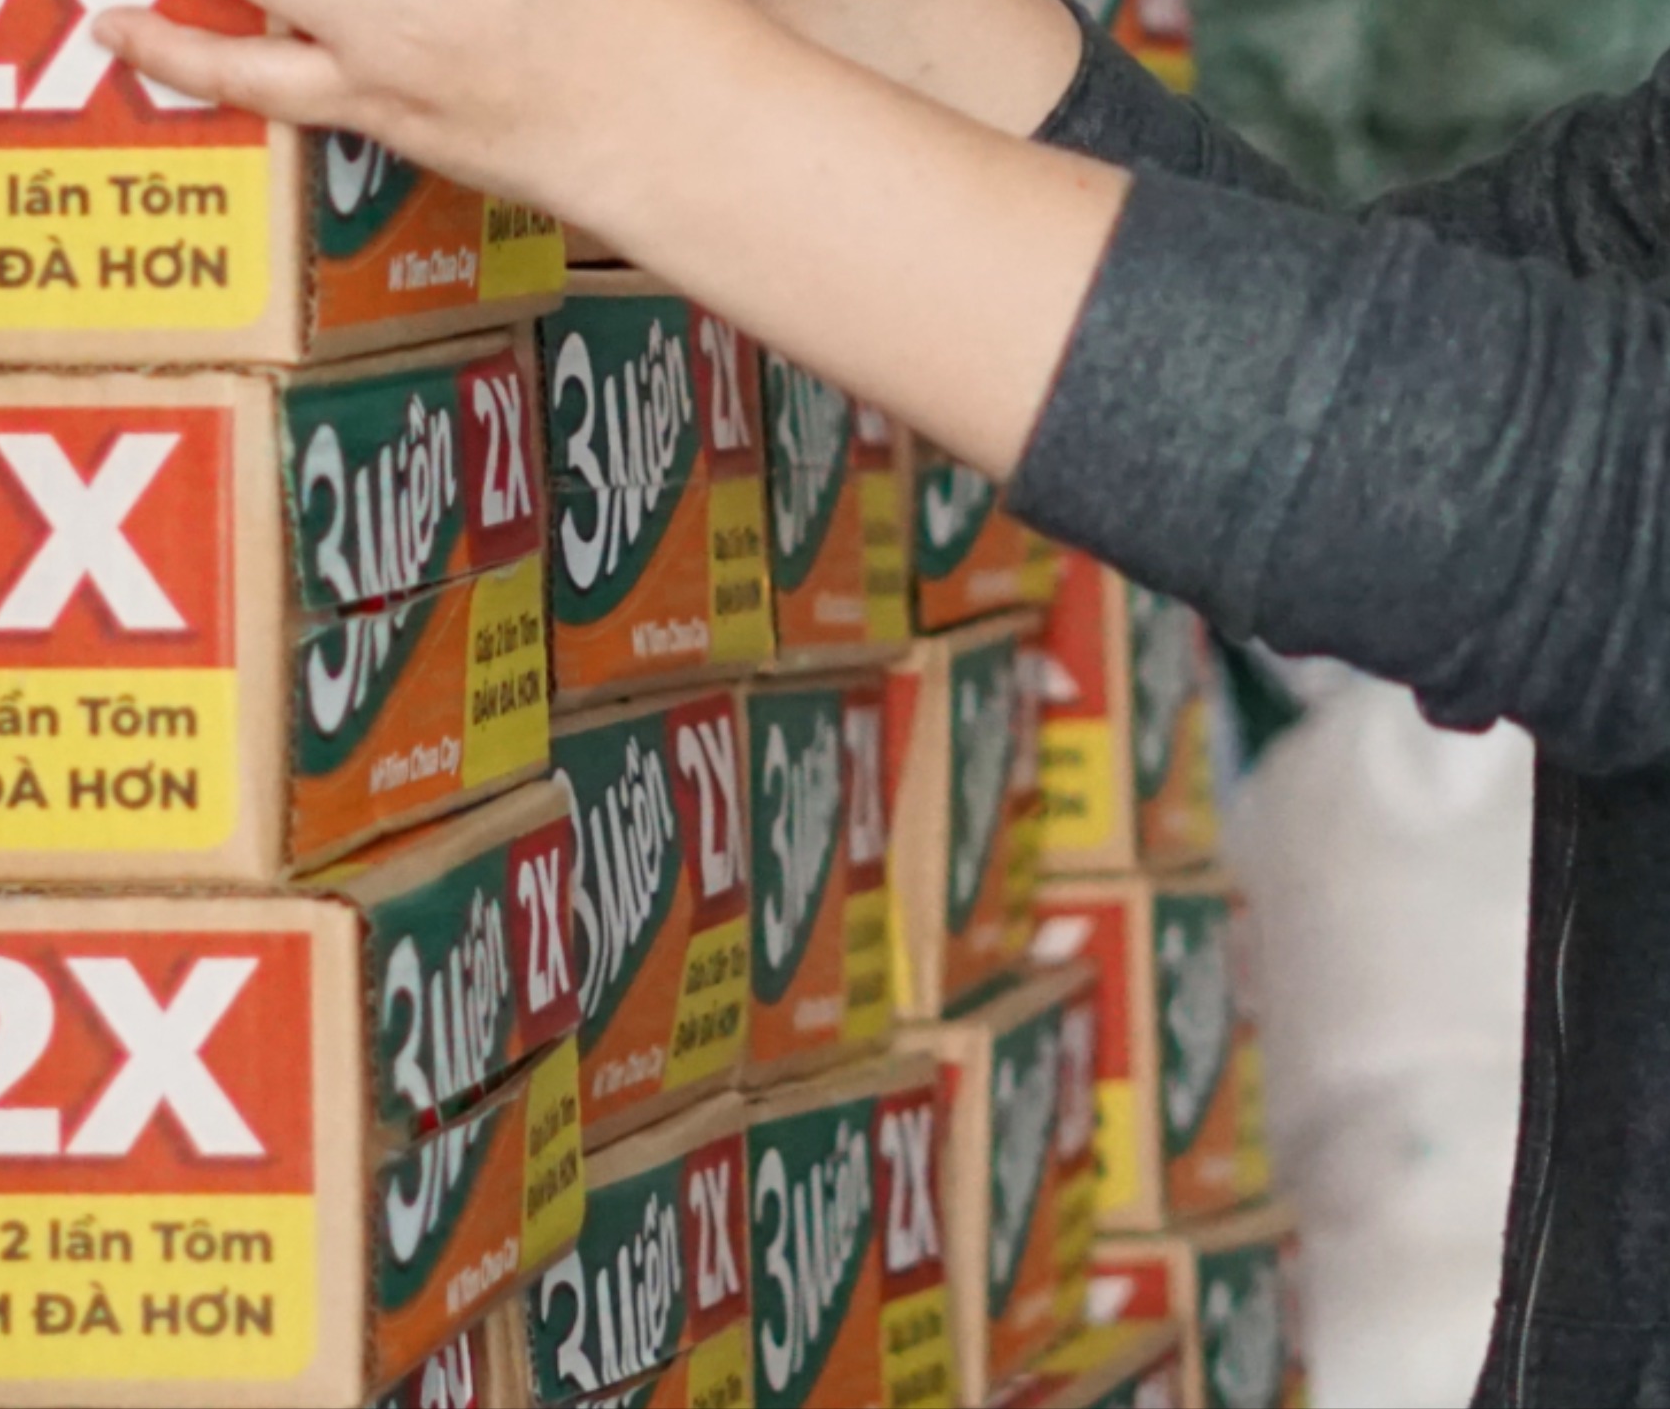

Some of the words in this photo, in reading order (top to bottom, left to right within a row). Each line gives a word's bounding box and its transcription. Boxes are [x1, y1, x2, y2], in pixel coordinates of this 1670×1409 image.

[8, 169, 90, 216] lần
[108, 171, 228, 217] Tôm
[100, 244, 229, 290] HƠN
[471, 373, 532, 529] 2X
[79, 695, 198, 737] Tôm
[69, 765, 199, 810] HƠN
[677, 717, 746, 898] 2X
[517, 848, 570, 1013] 2X
[880, 1106, 938, 1272] 2X
[2, 1223, 30, 1261] 2
[50, 1215, 132, 1261] lần
[152, 1218, 273, 1262] Tôm
[690, 1161, 740, 1310] 2X
[34, 1282, 118, 1335] ĐÀ
[141, 1291, 274, 1335] HƠN
